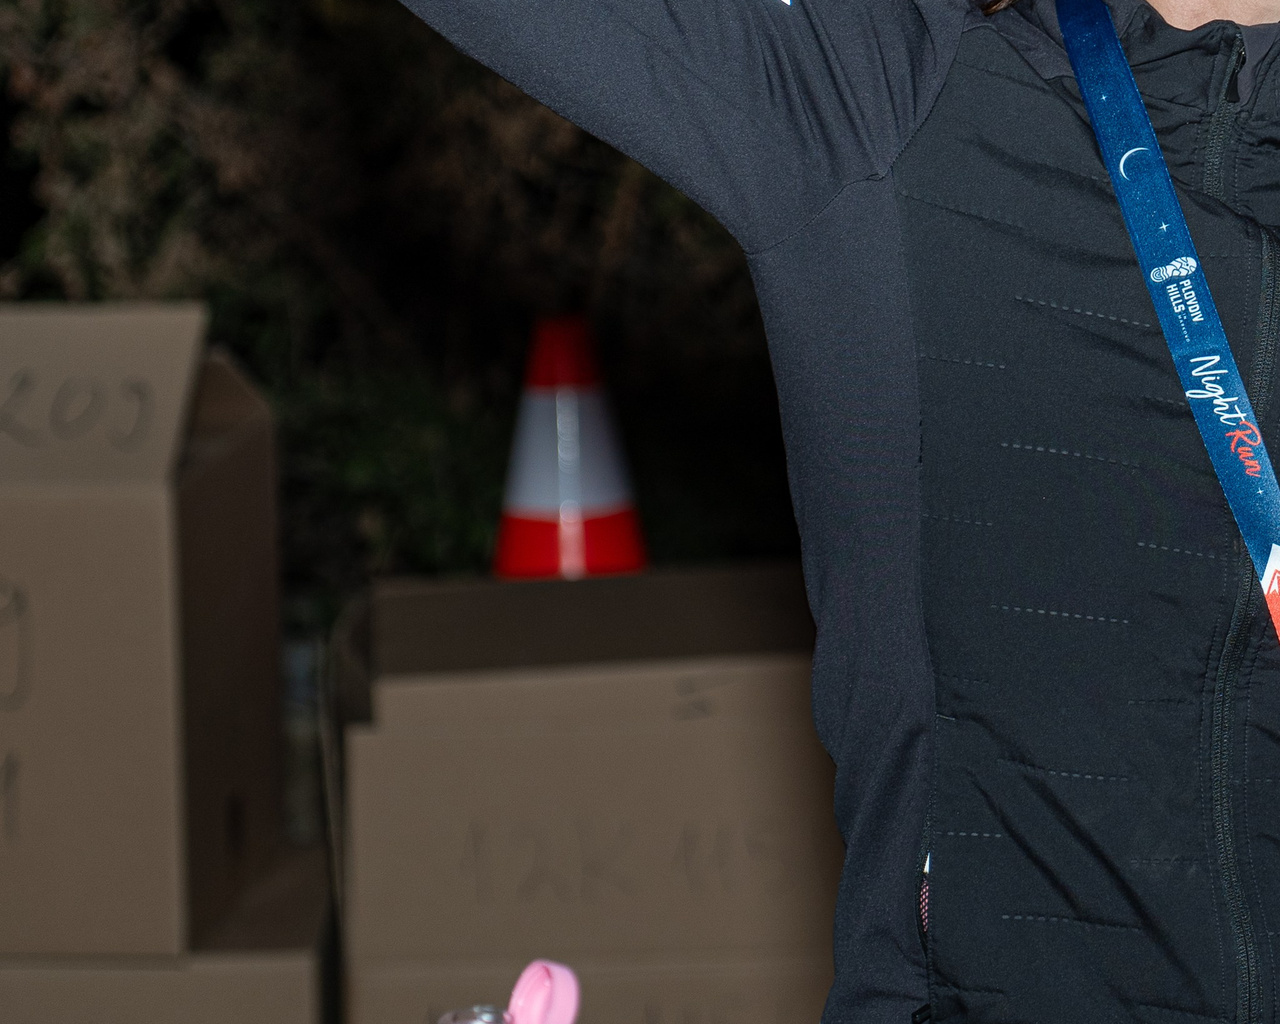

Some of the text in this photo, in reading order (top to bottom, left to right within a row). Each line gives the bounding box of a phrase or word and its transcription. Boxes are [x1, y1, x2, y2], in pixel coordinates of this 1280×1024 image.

[1166, 283, 1185, 313] HILLS
[1179, 279, 1204, 322] PLOVDIV
[1186, 355, 1262, 478] Night Run
